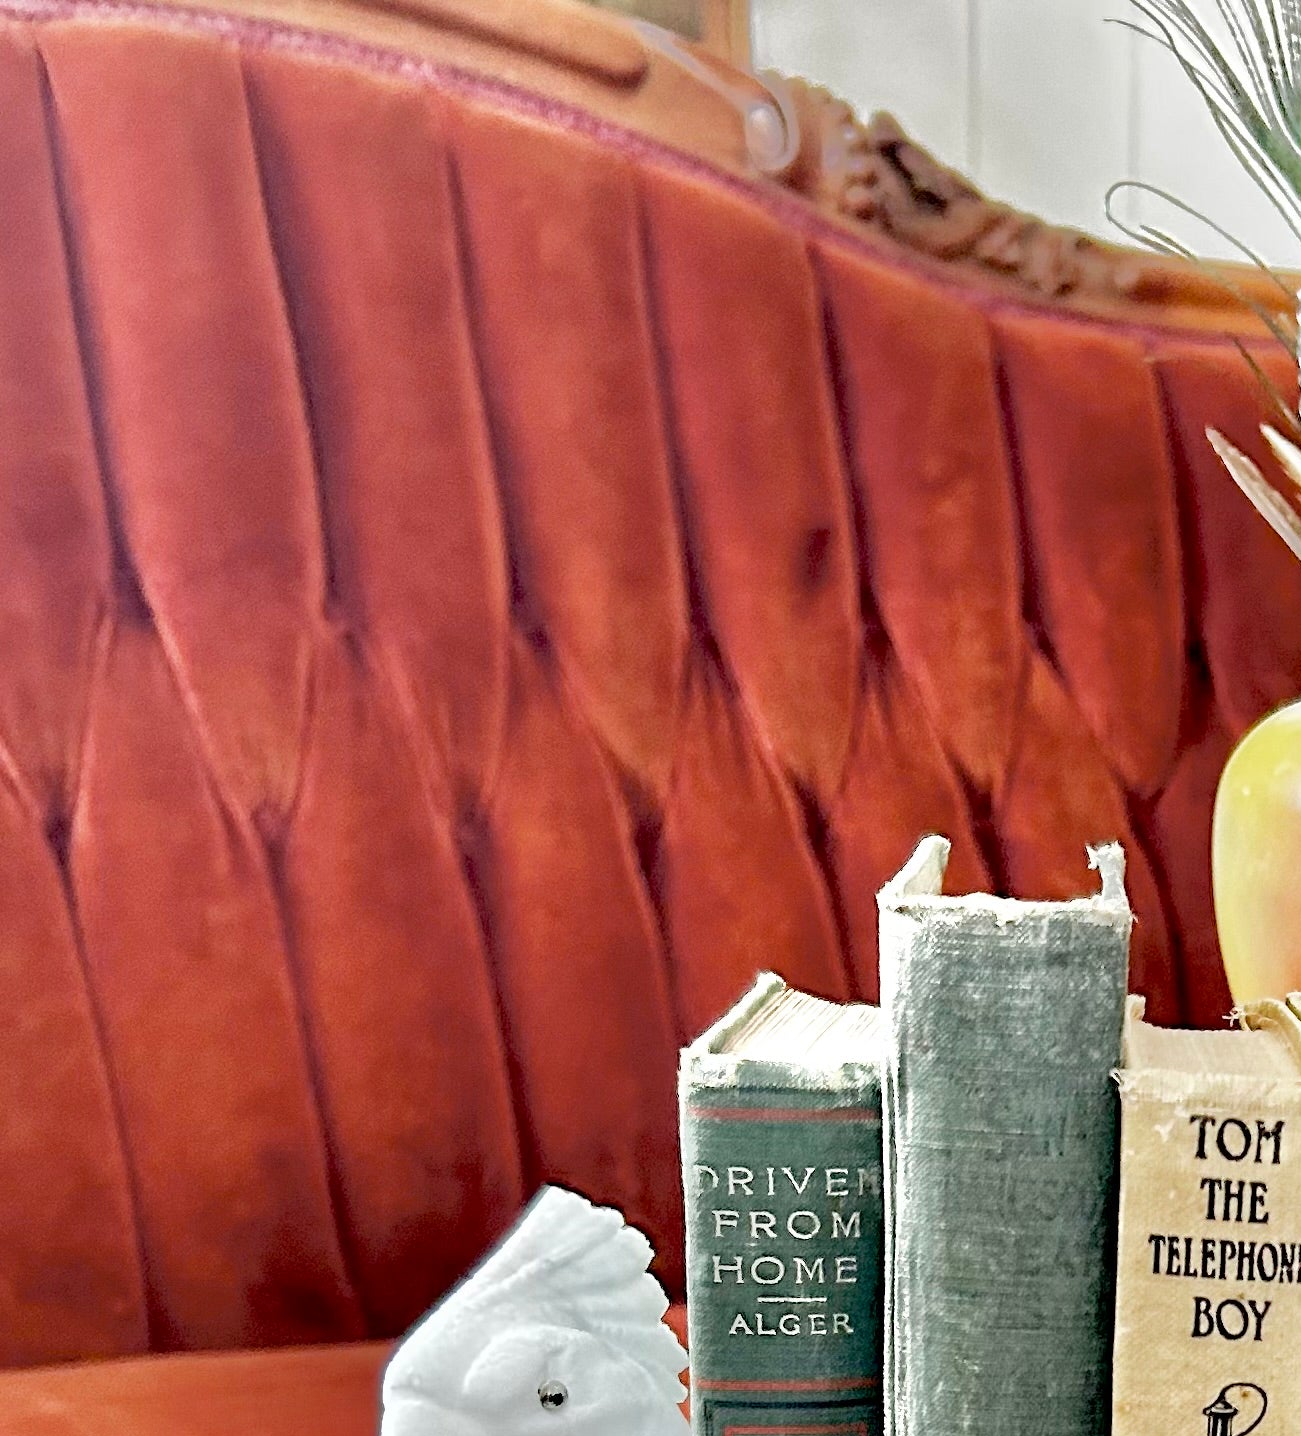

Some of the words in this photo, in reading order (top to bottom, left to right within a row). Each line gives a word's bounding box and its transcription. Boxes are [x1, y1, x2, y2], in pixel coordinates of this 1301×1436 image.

[1190, 1114, 1285, 1165] TOM
[1200, 1178, 1269, 1224] THE
[711, 1209, 862, 1240] FROM
[712, 1254, 858, 1285] HOME
[728, 1312, 854, 1336] ALGER
[1191, 1296, 1272, 1341] BOY
